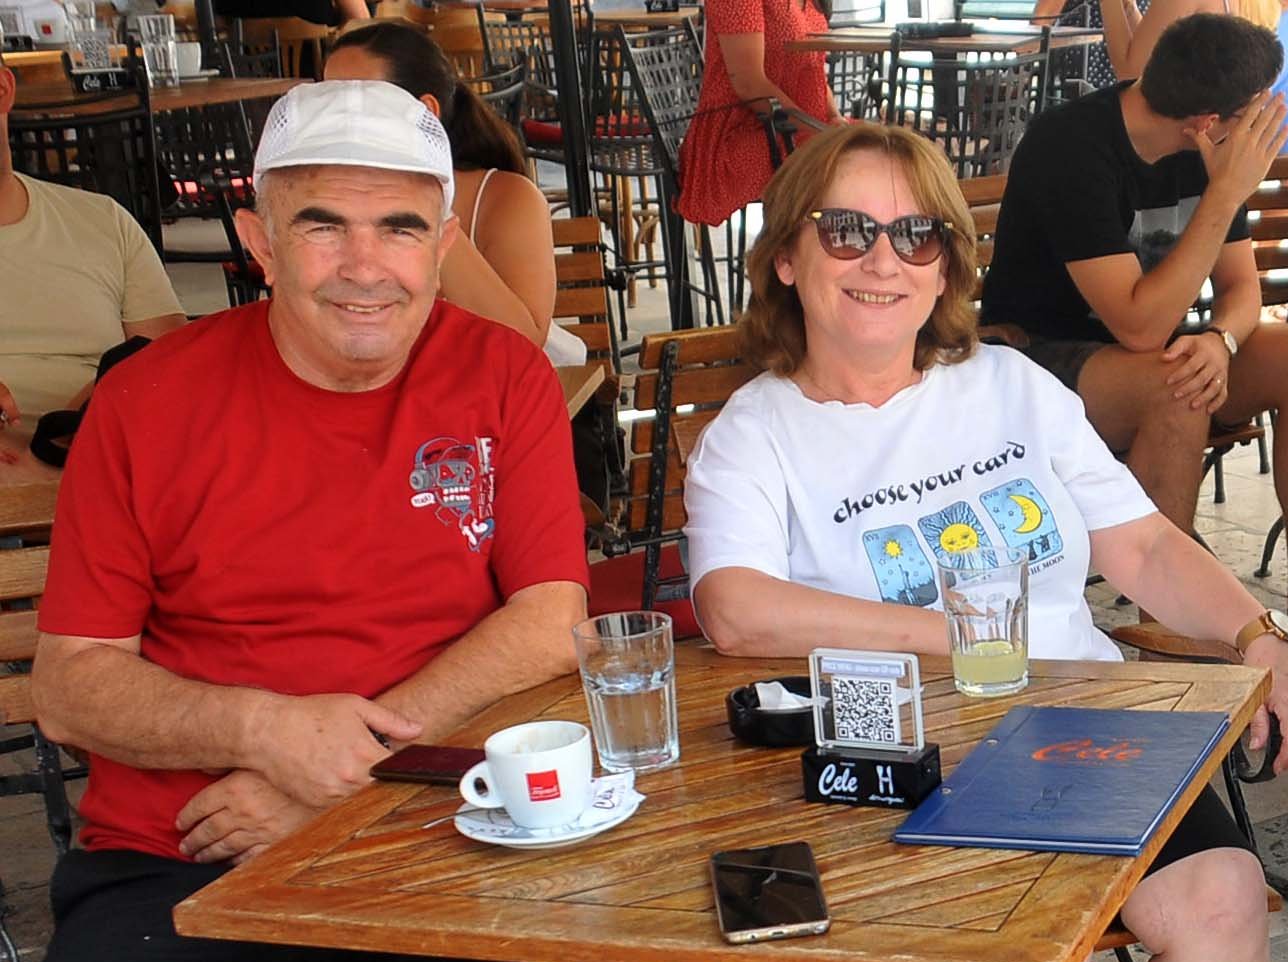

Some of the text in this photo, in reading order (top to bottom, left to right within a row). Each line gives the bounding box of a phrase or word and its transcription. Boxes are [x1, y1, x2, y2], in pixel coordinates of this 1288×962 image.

[833, 441, 1026, 523] choose your card
[818, 763, 894, 795] Cele H
